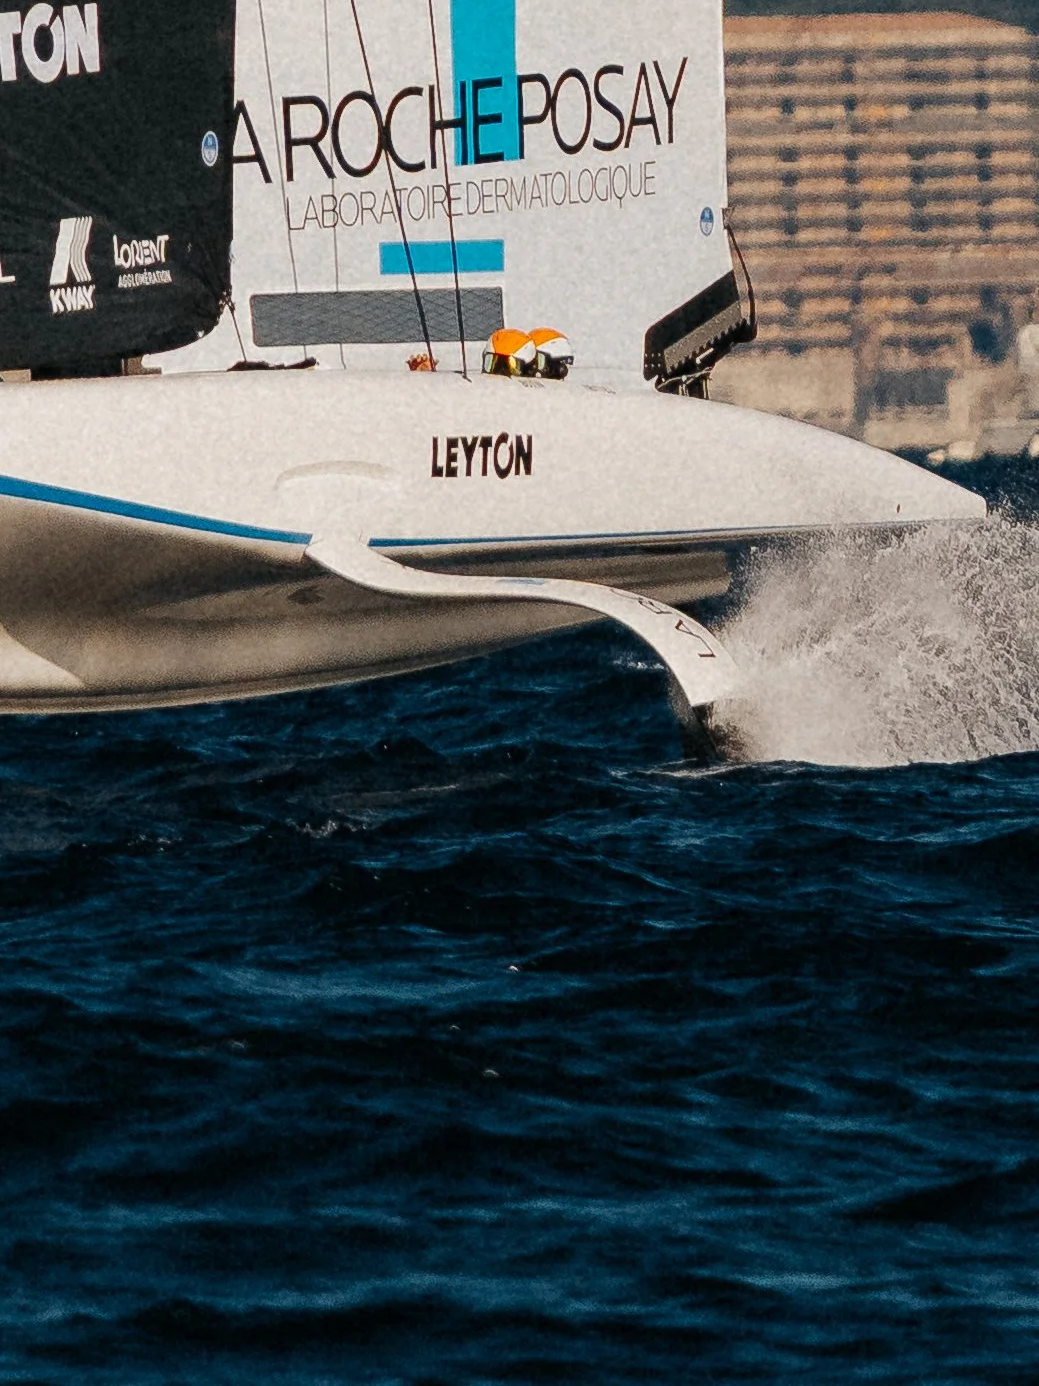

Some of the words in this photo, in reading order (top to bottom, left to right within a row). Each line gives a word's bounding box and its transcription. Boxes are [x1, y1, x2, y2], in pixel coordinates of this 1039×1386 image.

[233, 99, 273, 184] A
[281, 76, 505, 182] ROCHE
[515, 56, 689, 160] POSAY
[286, 181, 463, 231] LABORATOIRE
[466, 161, 657, 216] DERMATOLOGIQUE
[431, 431, 532, 480] LEYTON
